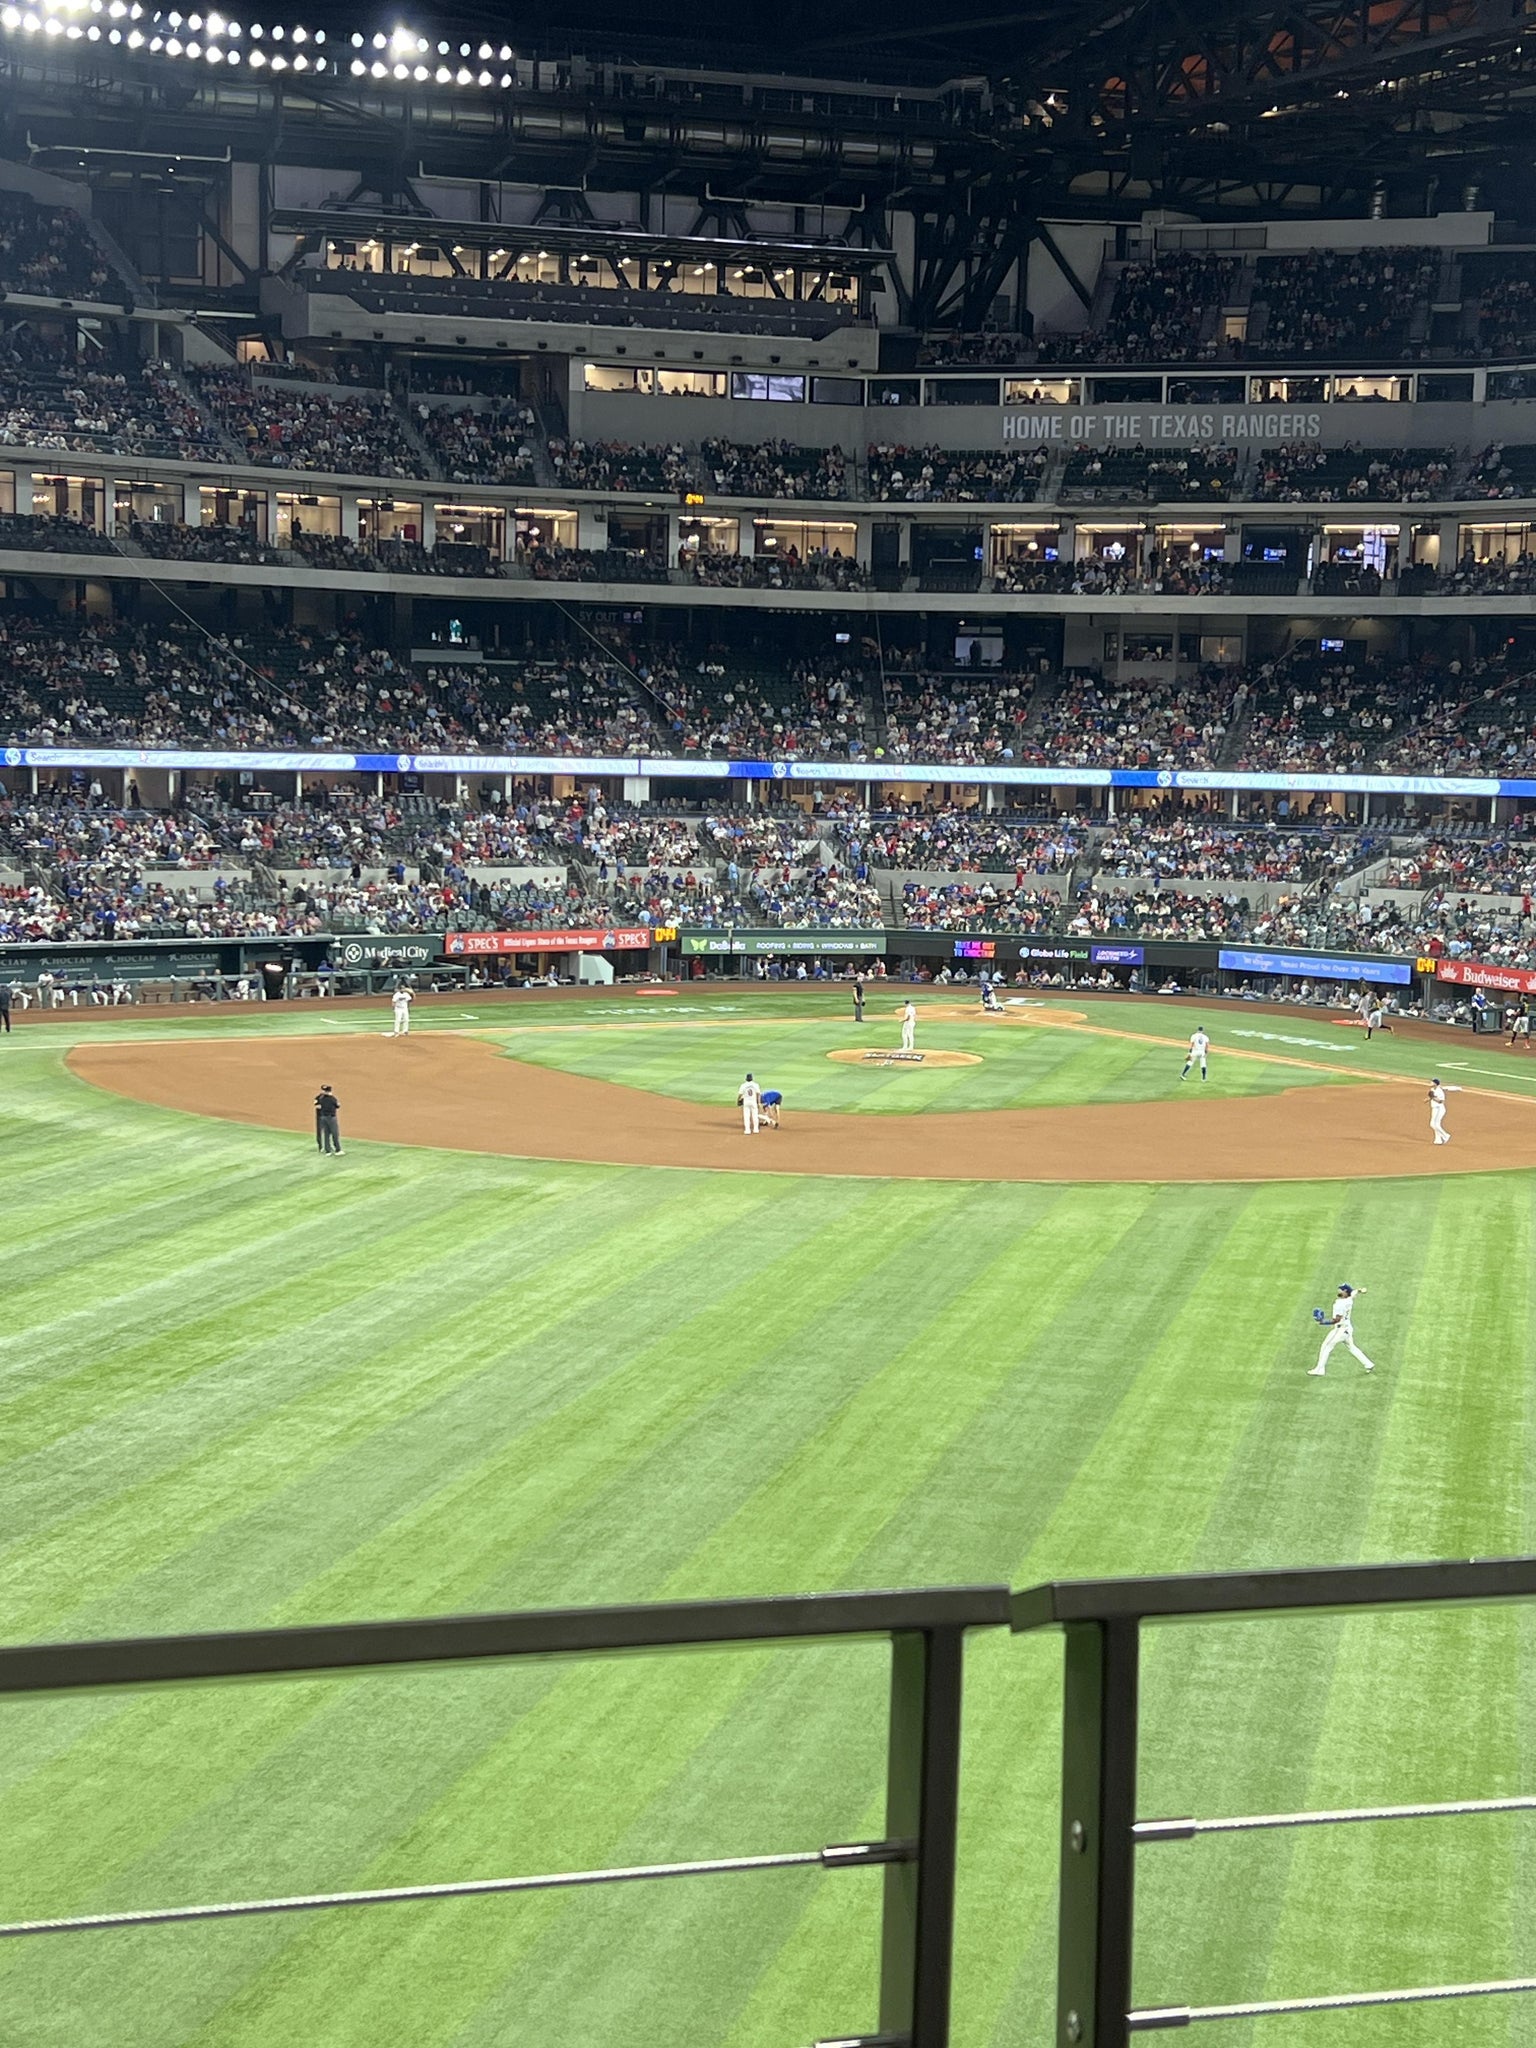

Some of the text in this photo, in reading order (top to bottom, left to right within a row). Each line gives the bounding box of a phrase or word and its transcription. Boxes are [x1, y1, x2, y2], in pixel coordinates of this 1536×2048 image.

[1003, 414, 1321, 439] HOME OF THE TEXAS RANGERS
[468, 937, 499, 950] SPEC'S
[618, 933, 647, 946] SPEC'S
[364, 945, 430, 960] Mdical City
[1030, 948, 1088, 959] Globe Life Field
[1463, 966, 1520, 989] Budweiser
